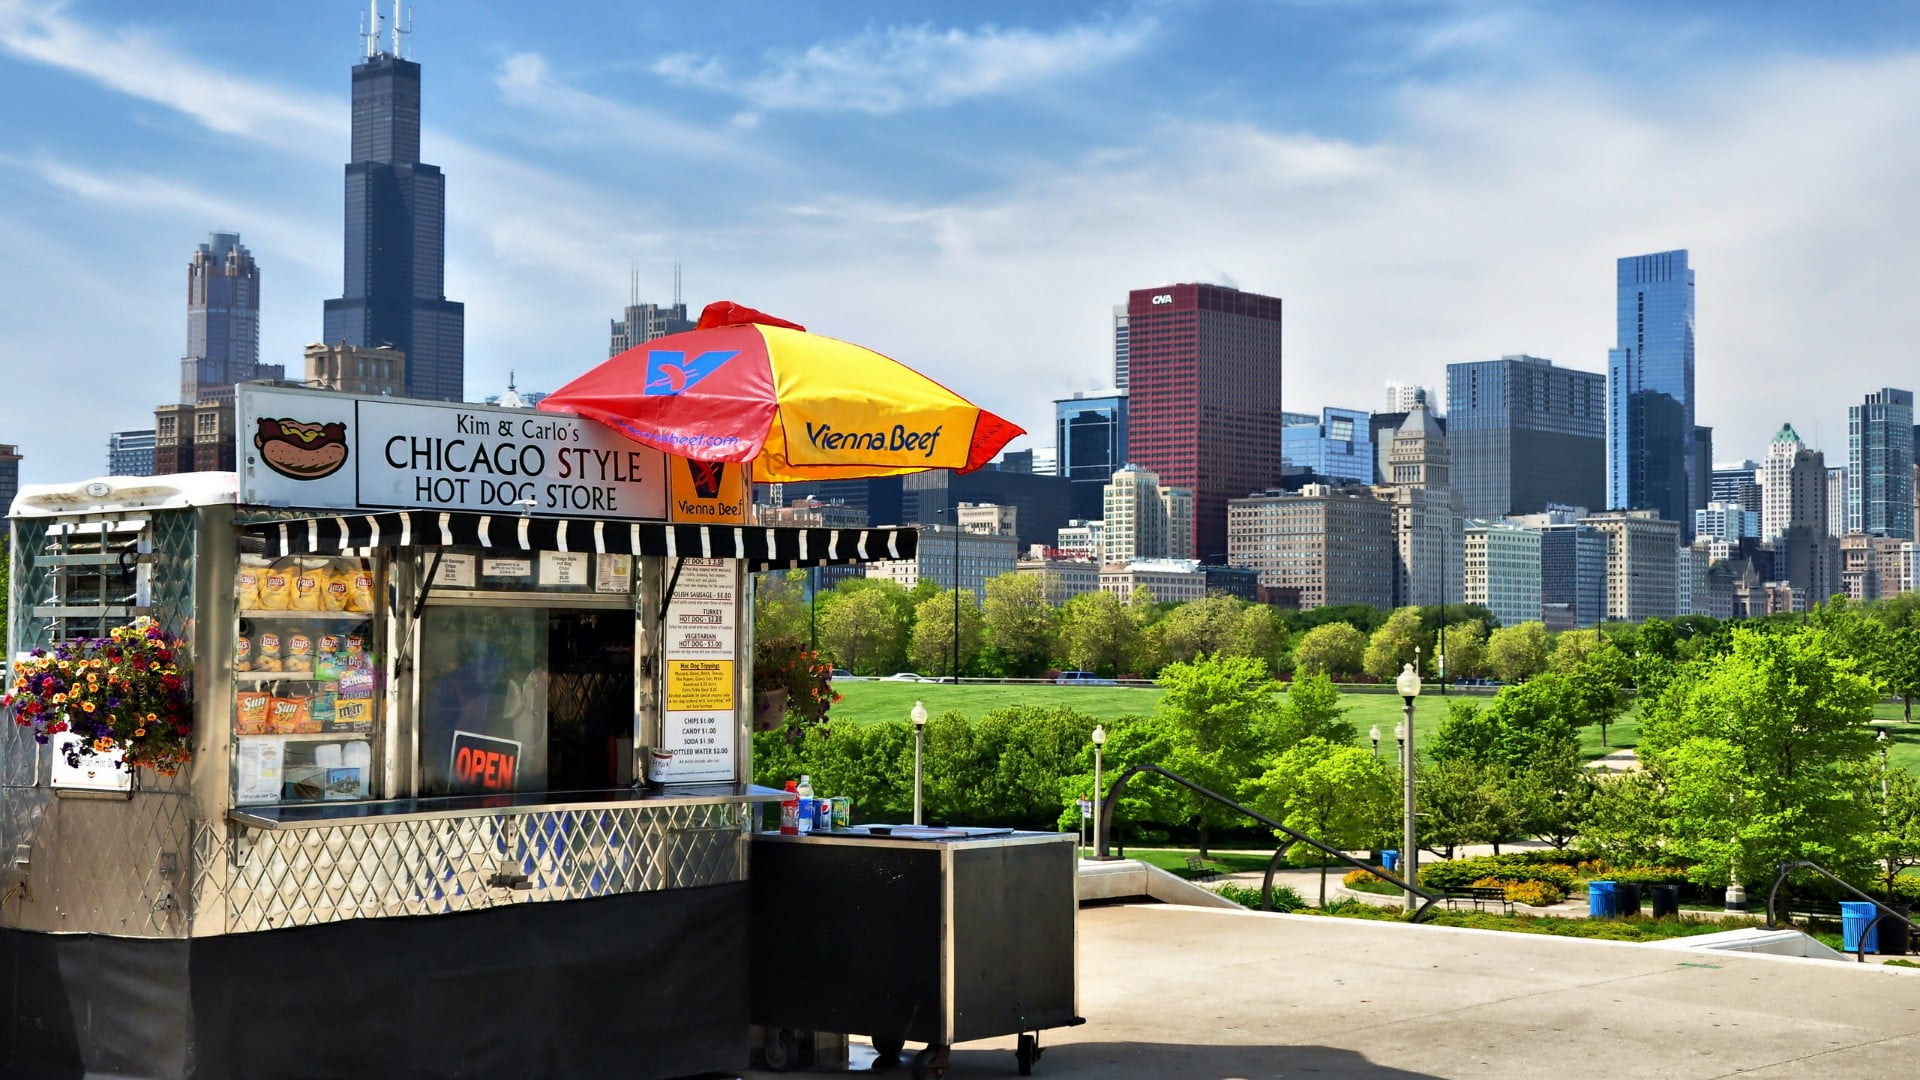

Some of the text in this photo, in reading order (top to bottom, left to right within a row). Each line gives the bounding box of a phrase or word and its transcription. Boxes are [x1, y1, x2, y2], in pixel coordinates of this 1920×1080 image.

[1152, 294, 1172, 305] CNA
[457, 414, 579, 442] Kim & Carlo's
[806, 422, 942, 458] Vienna Beef
[385, 435, 643, 483] CHICAGO STYLE
[416, 476, 618, 511] HOT DOG STORE
[678, 499, 743, 516] Vienna Beef
[244, 697, 266, 711] Sun
[275, 702, 297, 714] Sun
[456, 747, 514, 789] OPEN
